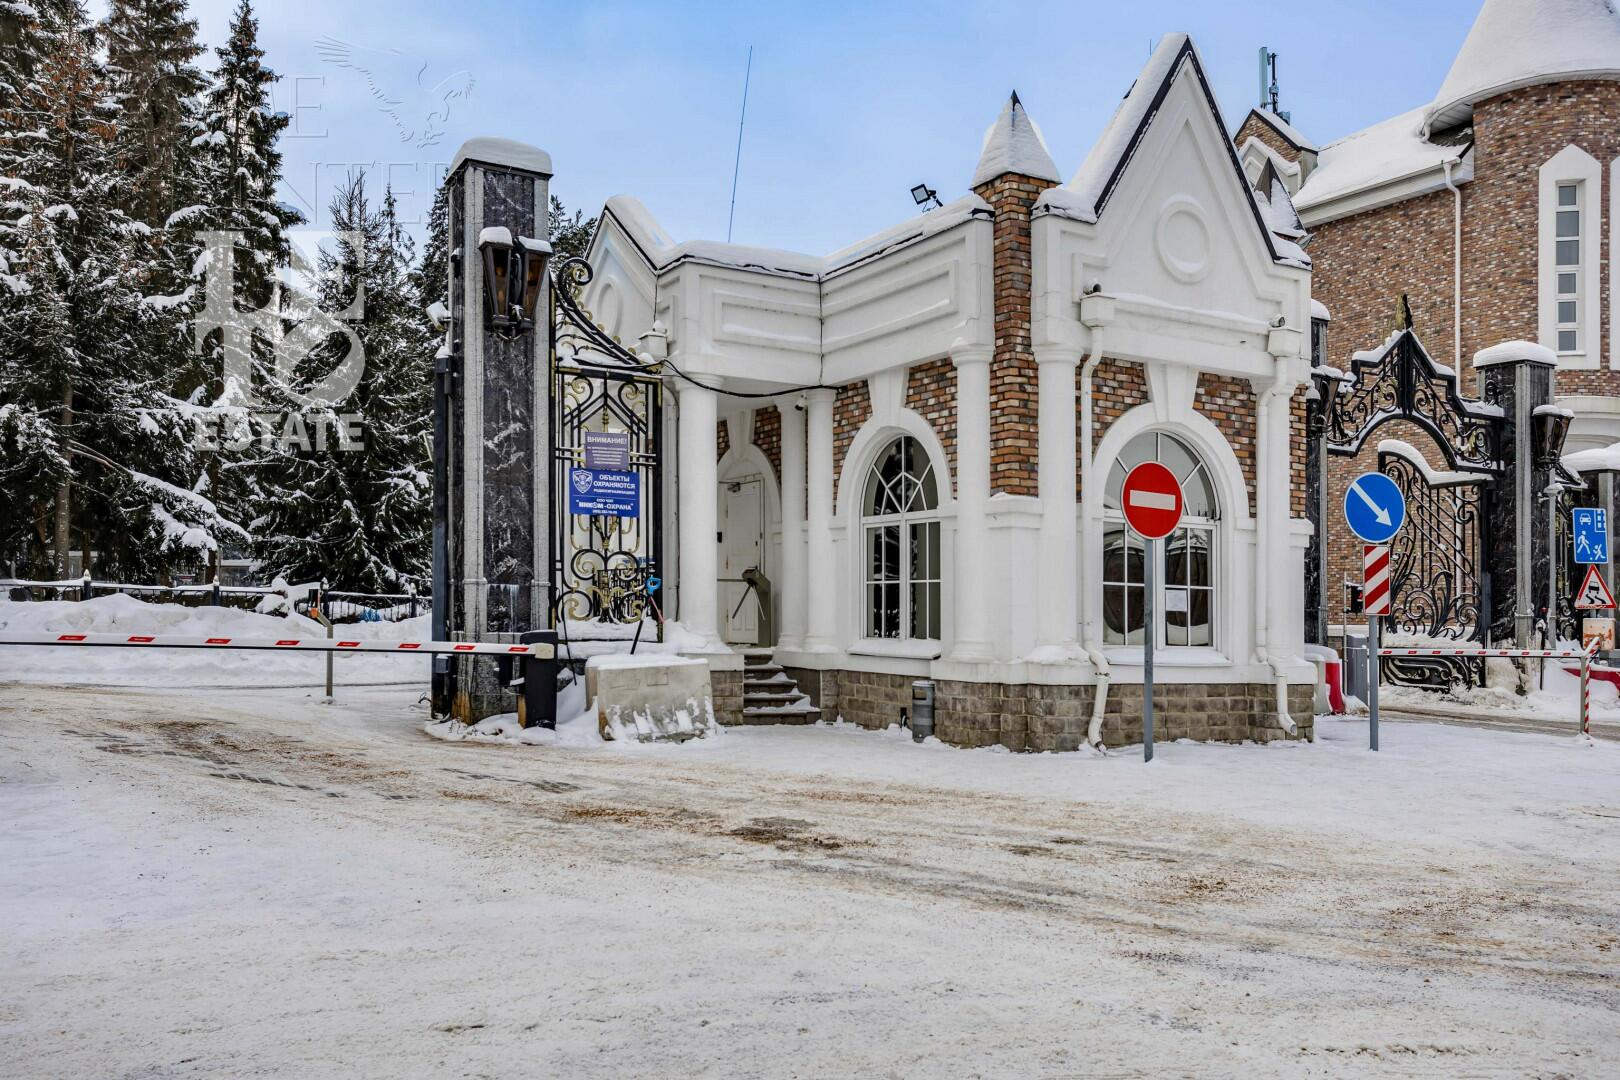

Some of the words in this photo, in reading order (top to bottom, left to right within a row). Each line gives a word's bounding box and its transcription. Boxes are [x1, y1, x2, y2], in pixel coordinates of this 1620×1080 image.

[587, 436, 627, 445] ВНИМАНИЕ!
[599, 474, 630, 482] ОБЪЕКТЫ
[593, 481, 636, 489] ОХРАНЯЮТСЯ
